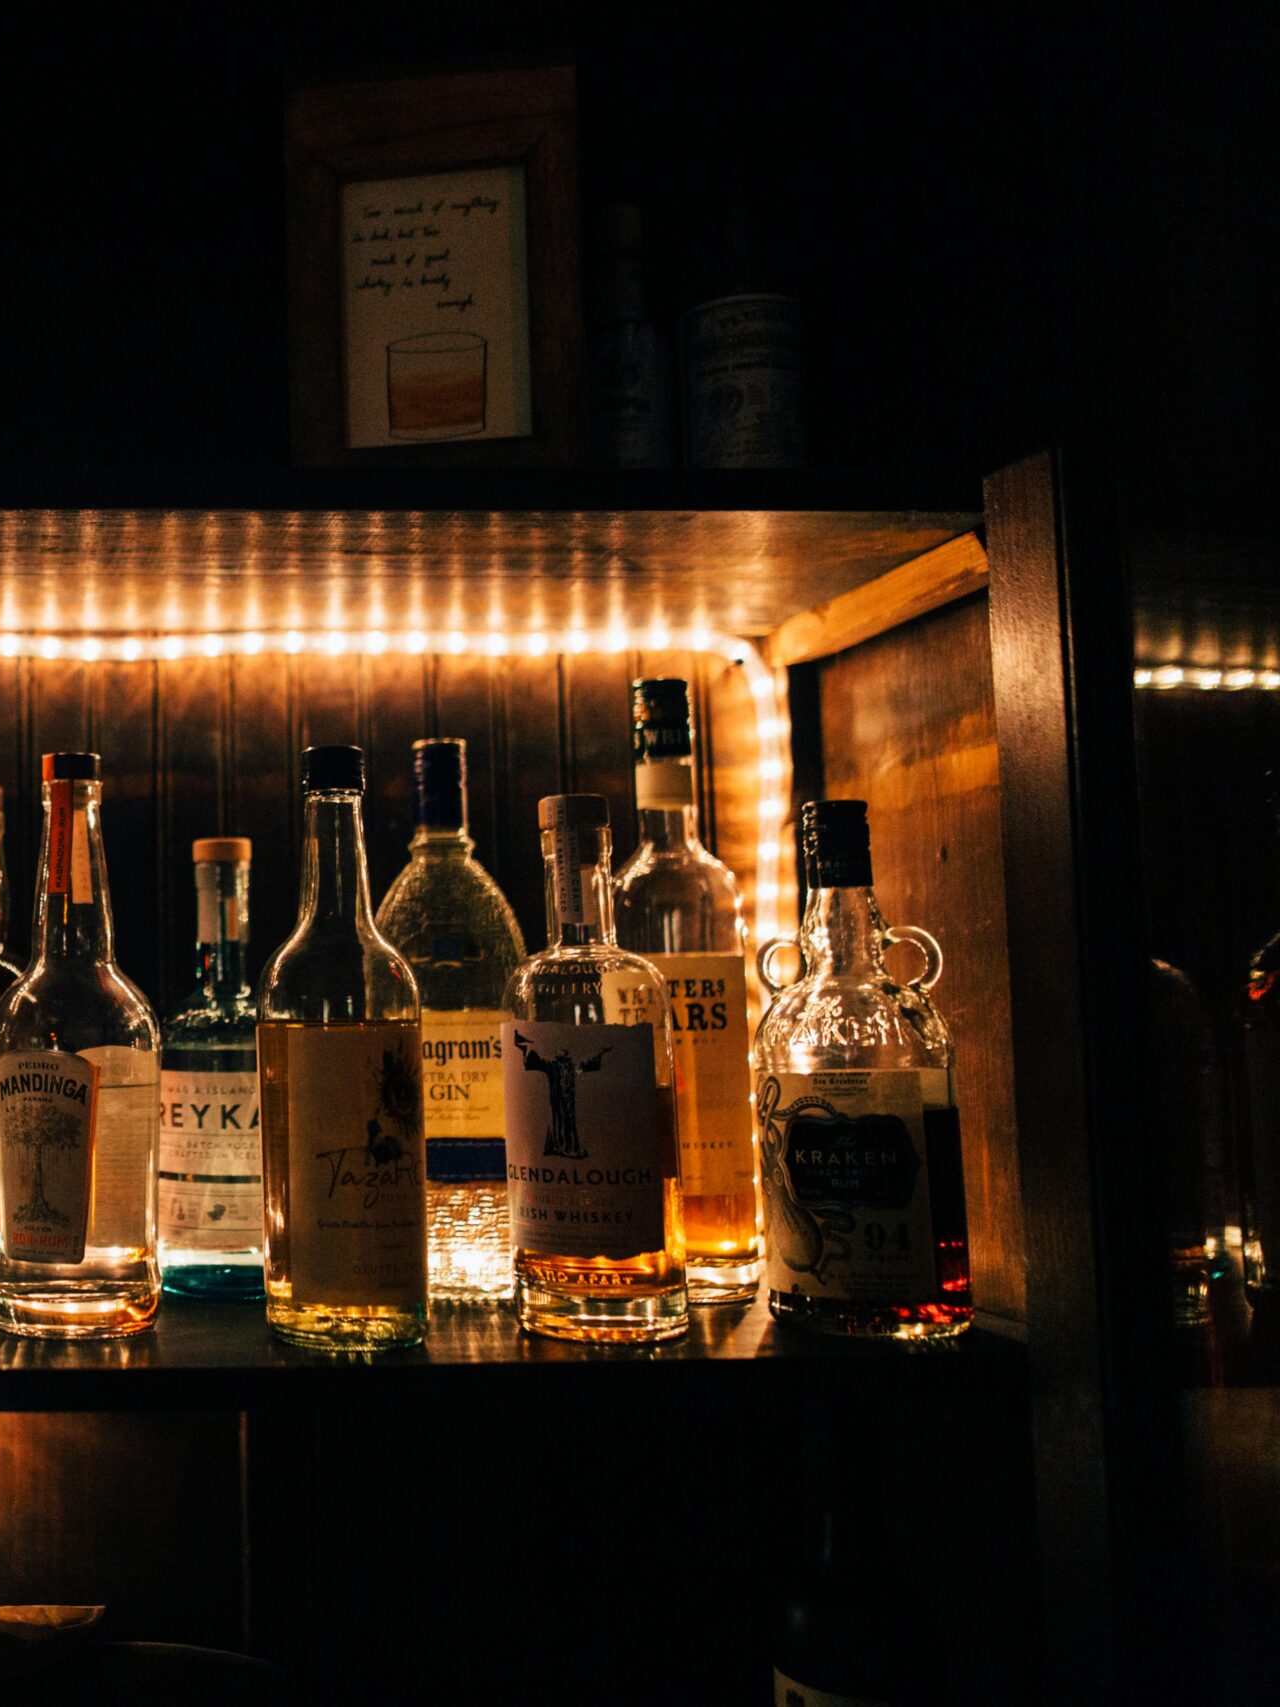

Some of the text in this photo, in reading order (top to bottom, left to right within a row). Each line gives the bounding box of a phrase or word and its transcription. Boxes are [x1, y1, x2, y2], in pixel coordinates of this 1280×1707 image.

[394, 201, 423, 215] much
[431, 200, 444, 216] of
[451, 196, 500, 218] anything
[422, 1035, 503, 1067] agram's
[17, 1061, 60, 1071] PEDRO
[461, 1070, 489, 1083] DRY
[0, 1072, 88, 1105] MANDINGA
[429, 1083, 471, 1102] GIN
[681, 1141, 733, 1150] HISKEY
[794, 1149, 898, 1166] KRAKEN
[508, 1163, 652, 1186] GLENDALOUGH
[830, 1177, 861, 1190] RUM
[520, 1207, 634, 1224] RISH WHISKEY
[863, 1221, 913, 1251] 94
